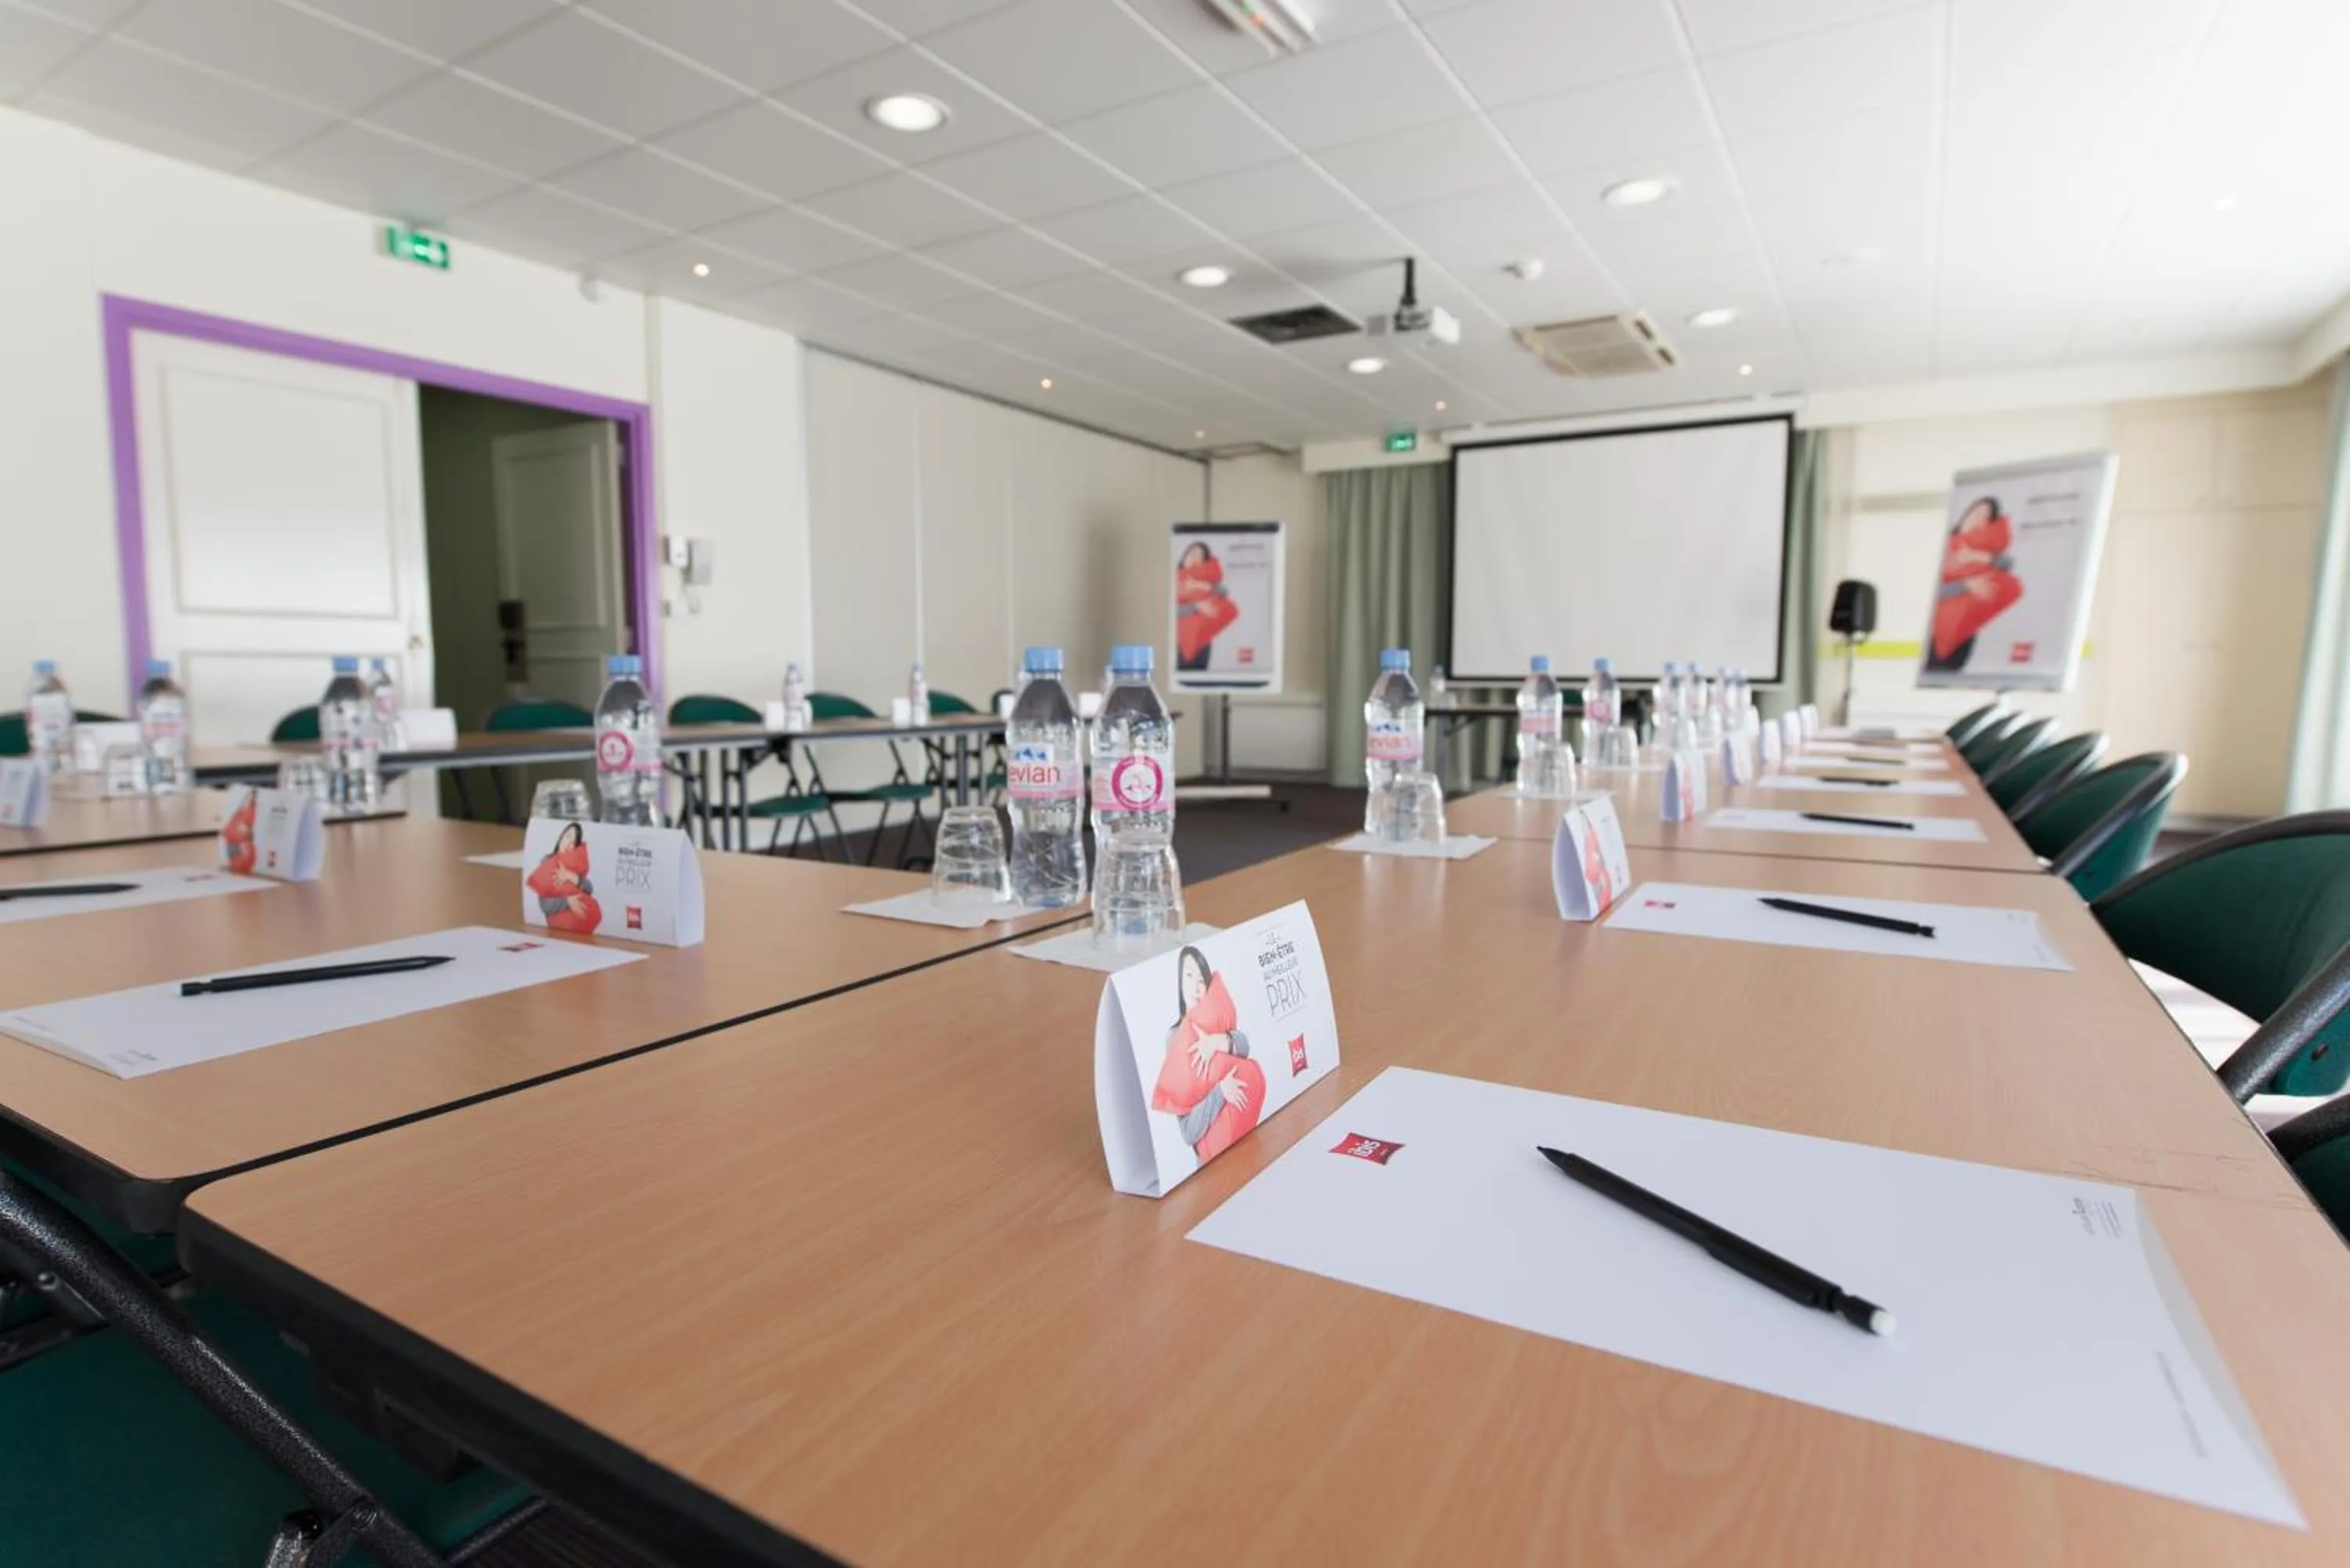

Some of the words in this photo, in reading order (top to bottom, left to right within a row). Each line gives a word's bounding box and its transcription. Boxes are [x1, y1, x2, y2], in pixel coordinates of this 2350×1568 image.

[1009, 765, 1061, 783] evian
[616, 865, 651, 891] PRIX
[1266, 970, 1307, 1017] PRIX
